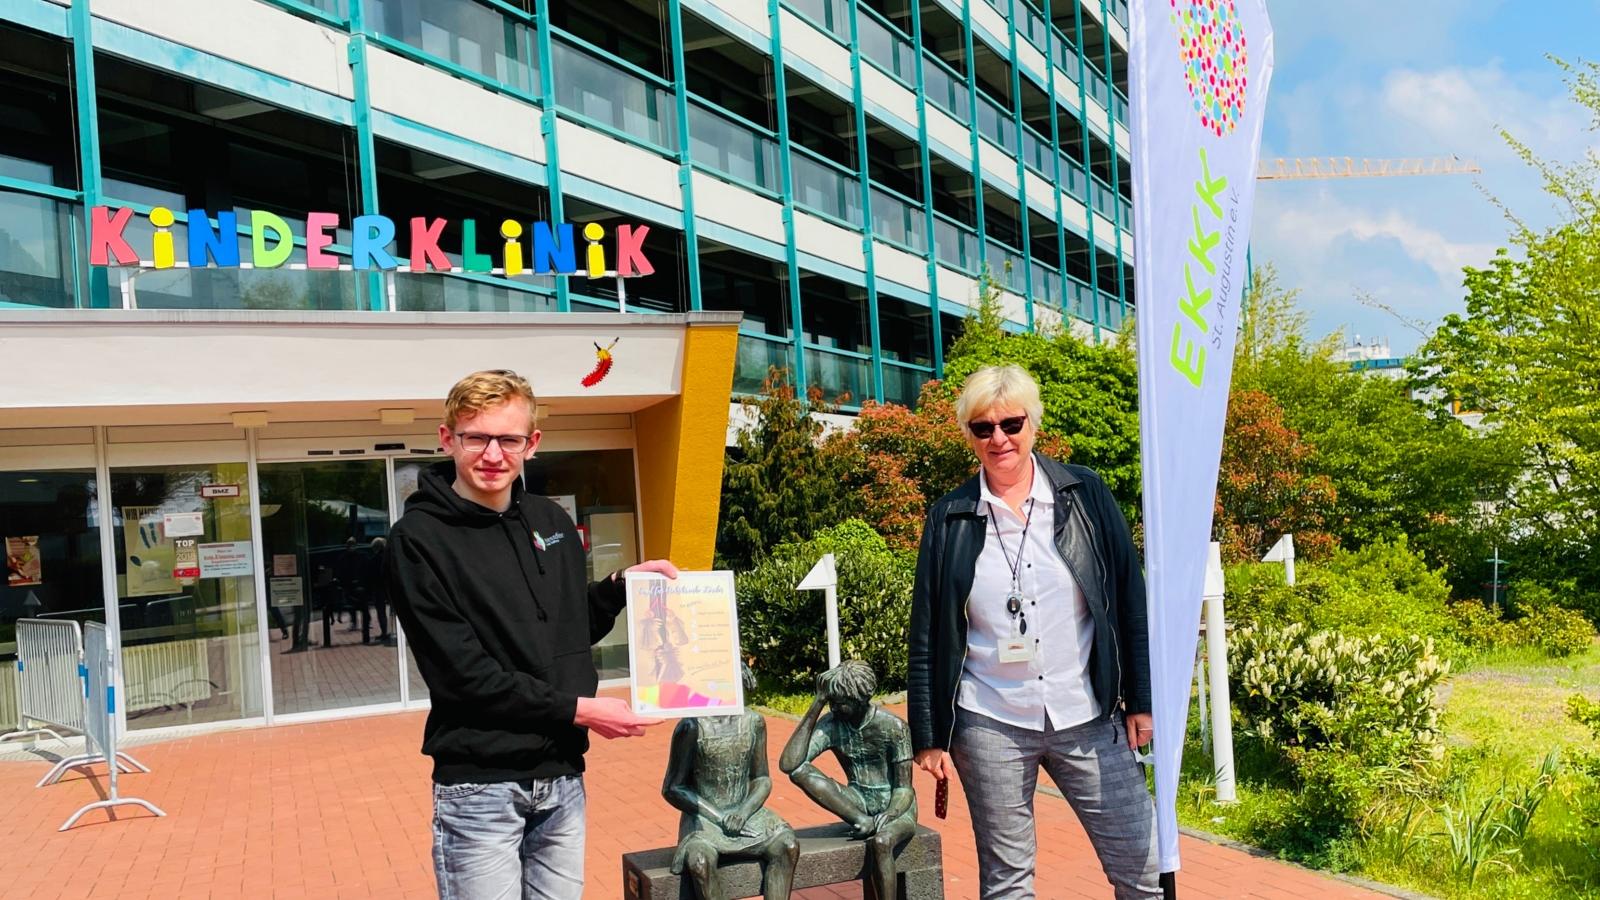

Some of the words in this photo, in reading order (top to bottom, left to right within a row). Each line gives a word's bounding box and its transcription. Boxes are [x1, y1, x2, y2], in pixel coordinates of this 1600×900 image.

[1169, 146, 1229, 389] EKKK
[1217, 226, 1237, 315] Augustin
[1211, 323, 1224, 350] St.
[175, 540, 195, 548] TOP
